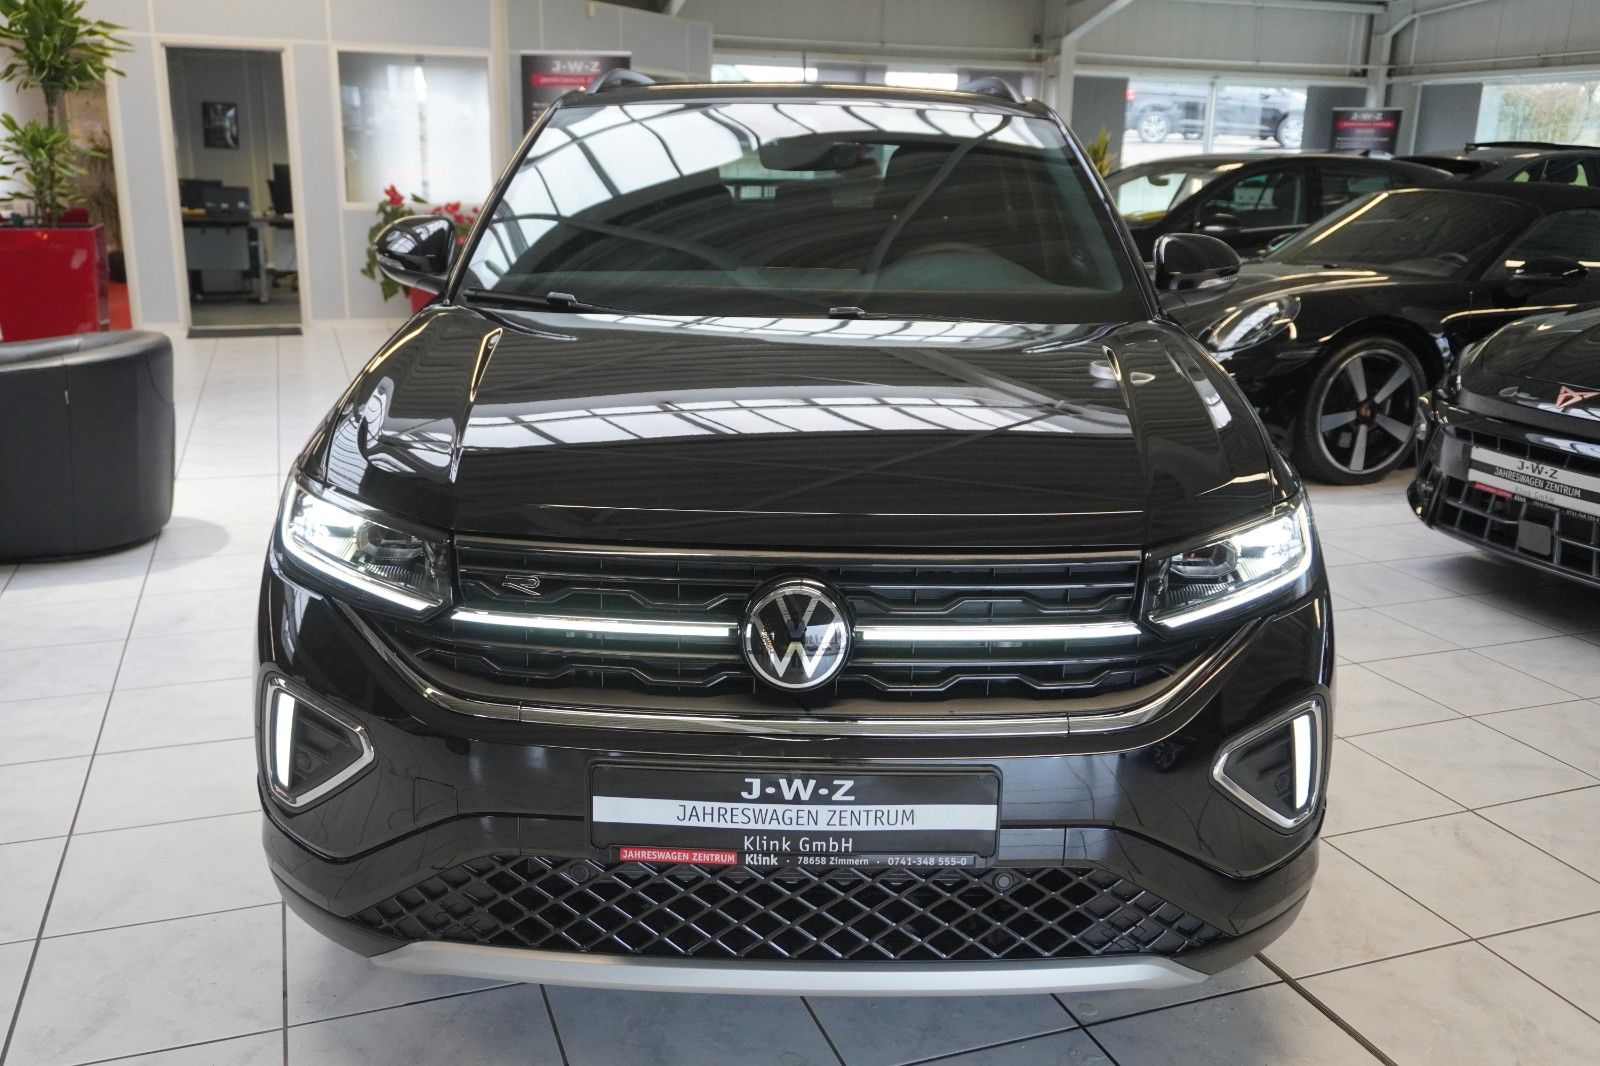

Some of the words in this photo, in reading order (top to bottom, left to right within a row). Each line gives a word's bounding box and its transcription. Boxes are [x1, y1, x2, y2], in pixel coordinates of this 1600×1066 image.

[1494, 467, 1544, 488] JAHRESWAGEN
[1544, 481, 1581, 498] ZENTRUM
[676, 804, 819, 827] JAHRESWAGEN
[826, 808, 916, 827] ZENTRUM
[743, 835, 792, 852] Klink
[799, 837, 854, 853] GmbH
[622, 849, 689, 861] JAHRESWAGEN
[692, 852, 735, 863] ZENTRUM
[745, 854, 778, 866] Klink
[797, 856, 827, 866] 78658
[829, 856, 869, 866] Zimmern
[887, 857, 935, 867] 0741-348
[938, 857, 967, 867] 555-0
